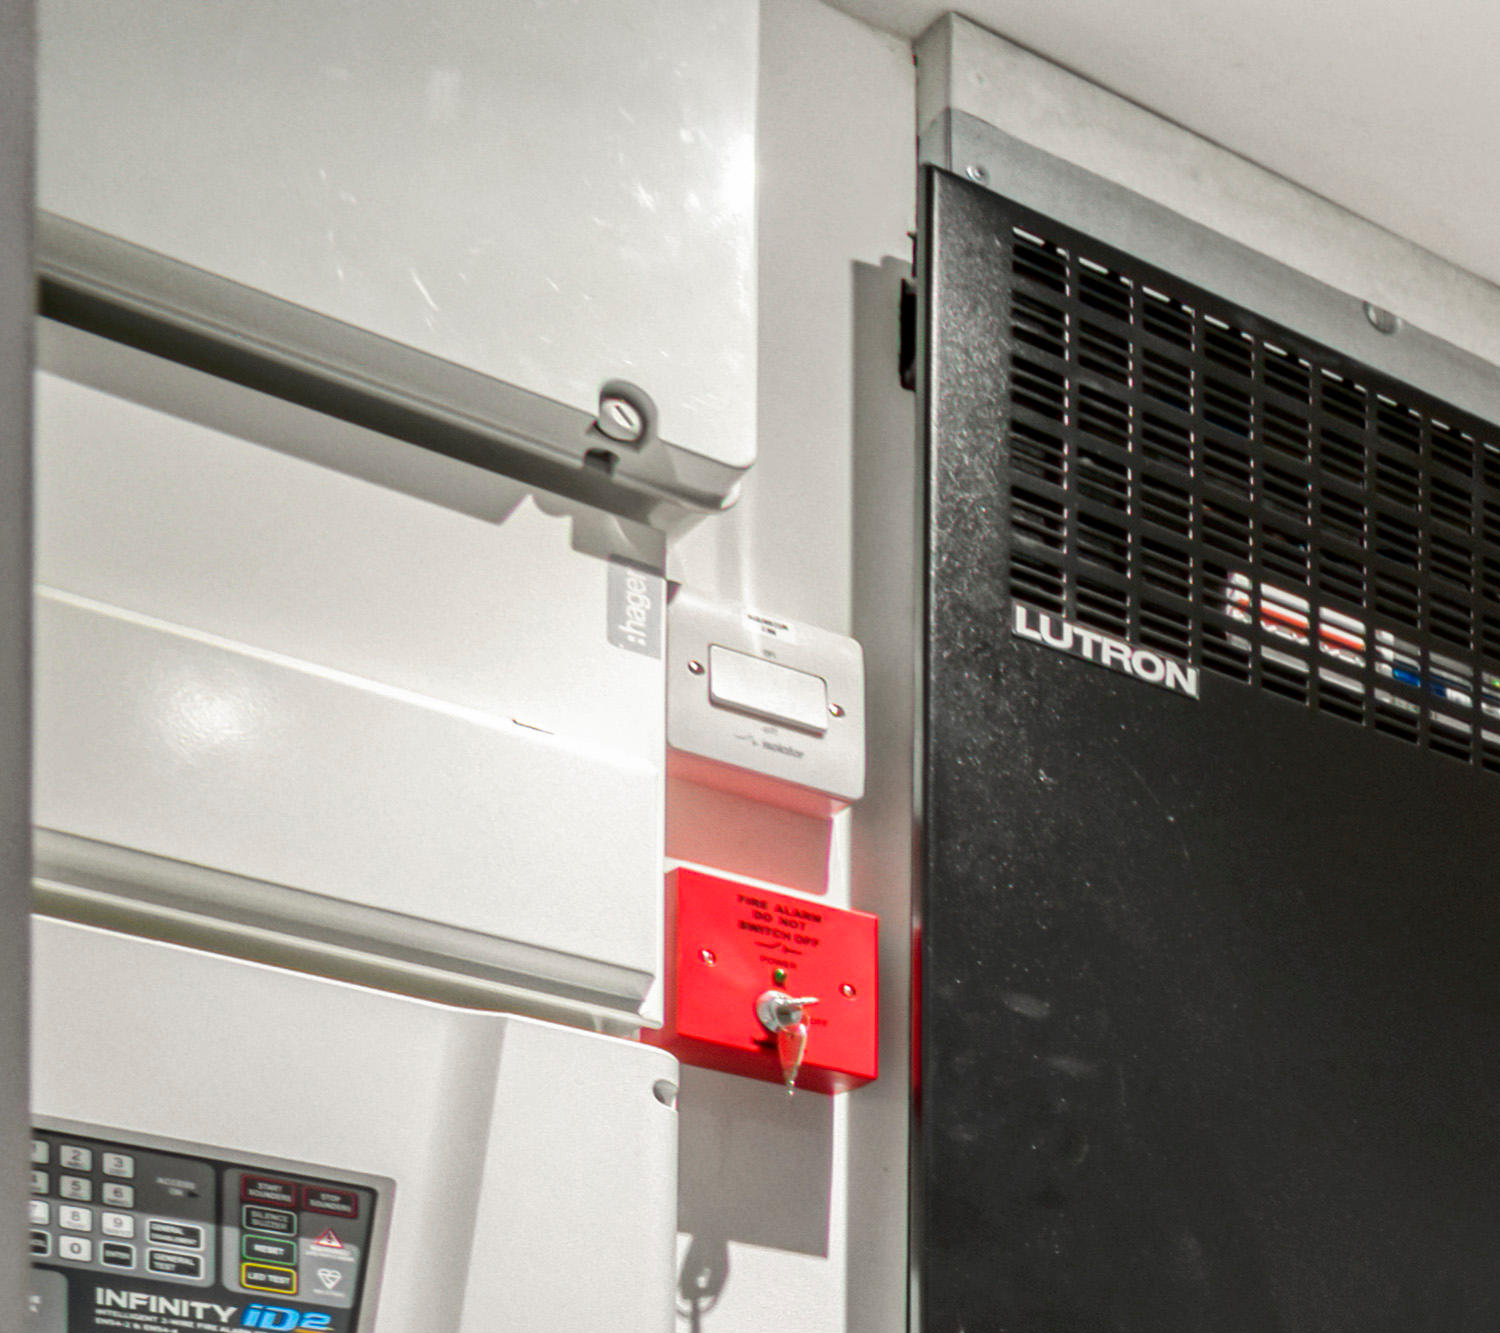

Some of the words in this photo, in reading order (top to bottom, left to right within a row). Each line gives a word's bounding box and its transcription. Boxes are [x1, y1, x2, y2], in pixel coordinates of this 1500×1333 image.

[1015, 604, 1198, 697] LUTRON
[738, 894, 767, 909] FIRE
[775, 904, 822, 923] ALARM
[754, 910, 772, 921] DO
[780, 917, 807, 930] NOT
[738, 920, 792, 940] SWITCH
[795, 932, 820, 947] OFF
[71, 1151, 81, 1161] 2
[113, 1158, 123, 1168] 3
[71, 1180, 81, 1190] 5
[113, 1188, 123, 1198] 6
[71, 1212, 80, 1221] 8
[113, 1218, 123, 1227] 9
[69, 1243, 81, 1254] 0
[253, 1243, 285, 1255] RESET
[247, 1271, 267, 1281] LED
[268, 1274, 291, 1285] TEST
[94, 1286, 239, 1324] INFINITY
